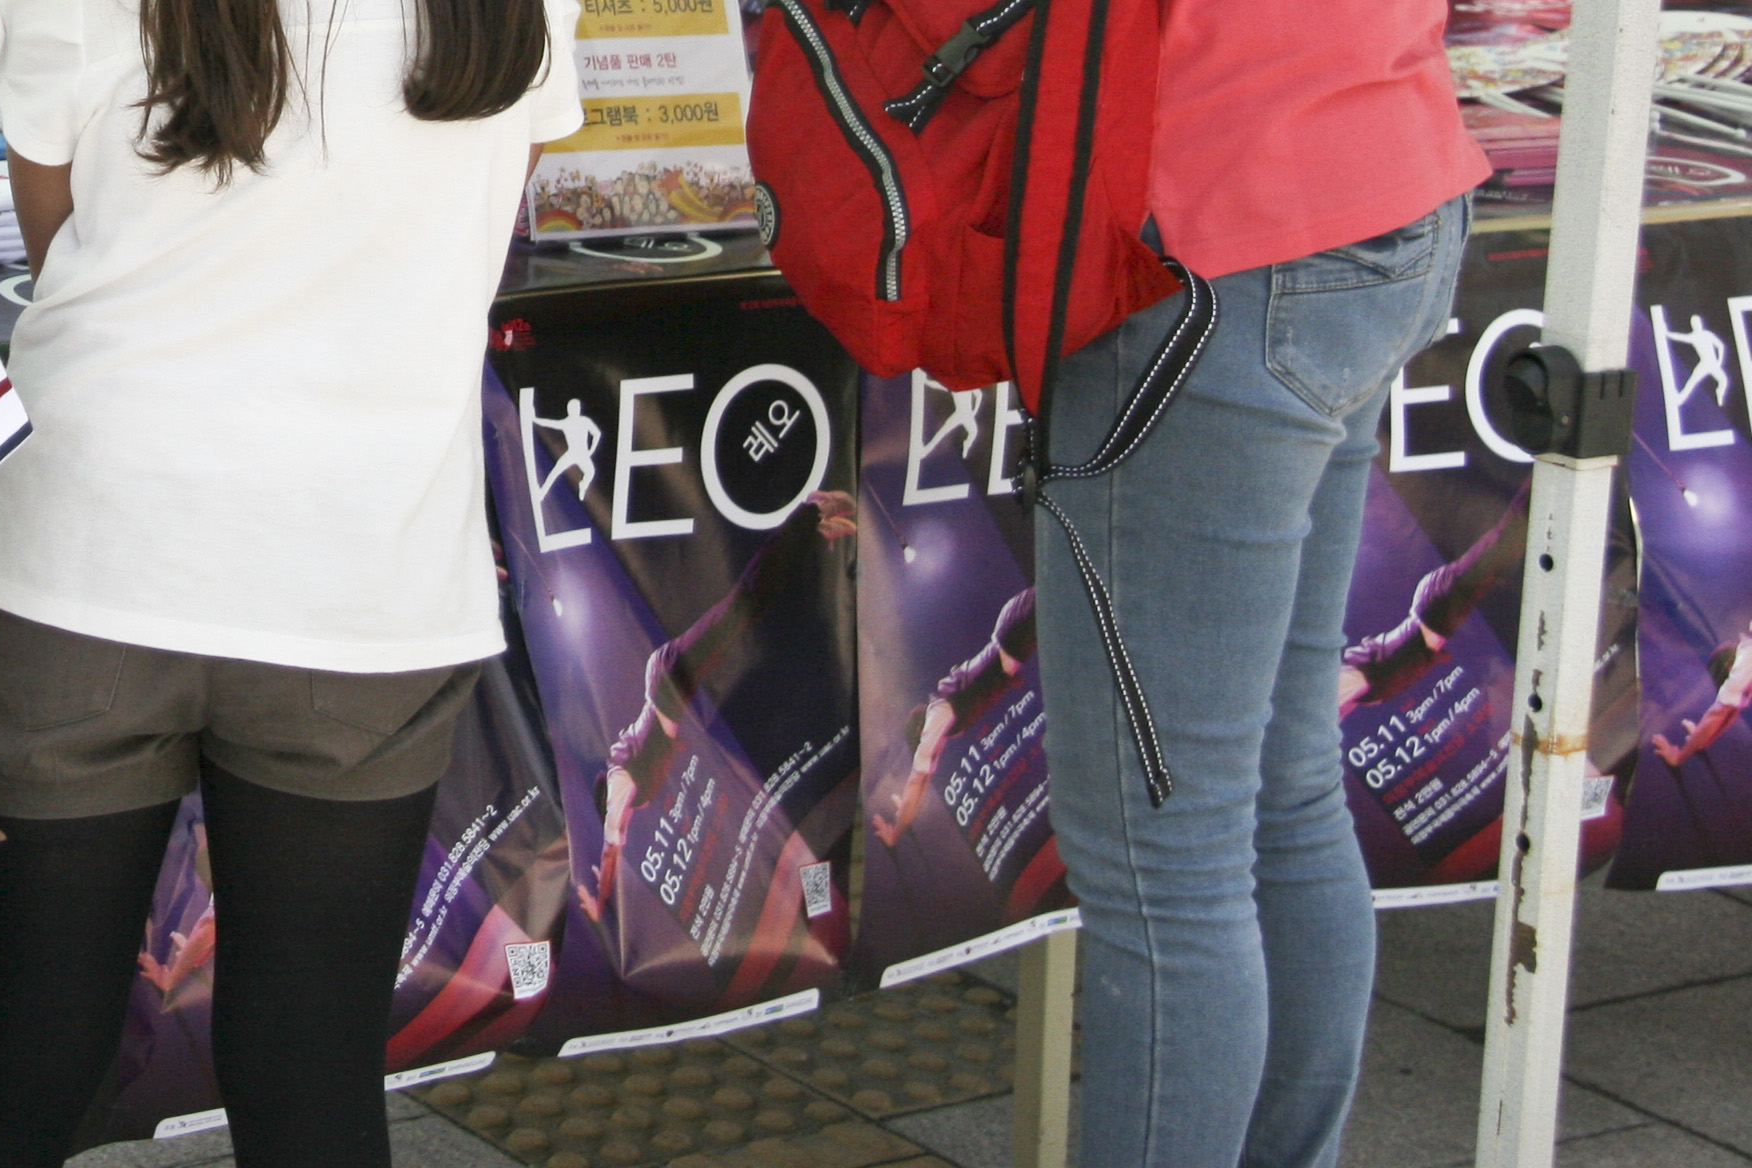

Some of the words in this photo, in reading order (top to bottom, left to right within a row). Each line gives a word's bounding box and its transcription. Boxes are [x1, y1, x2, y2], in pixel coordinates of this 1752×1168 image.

[584, 54, 621, 71] 기념품
[627, 54, 652, 70] 판매
[658, 100, 720, 124] 3,000원
[519, 363, 831, 554] LEO
[742, 398, 801, 463] 레오
[1348, 715, 1406, 767] 05.11
[1365, 735, 1426, 789] 05.12
[944, 745, 981, 806] 05.11
[956, 764, 995, 827] 05.12
[488, 785, 541, 842] www.uac.or.kr
[640, 817, 674, 883] 05.11
[659, 838, 693, 905] 05.12
